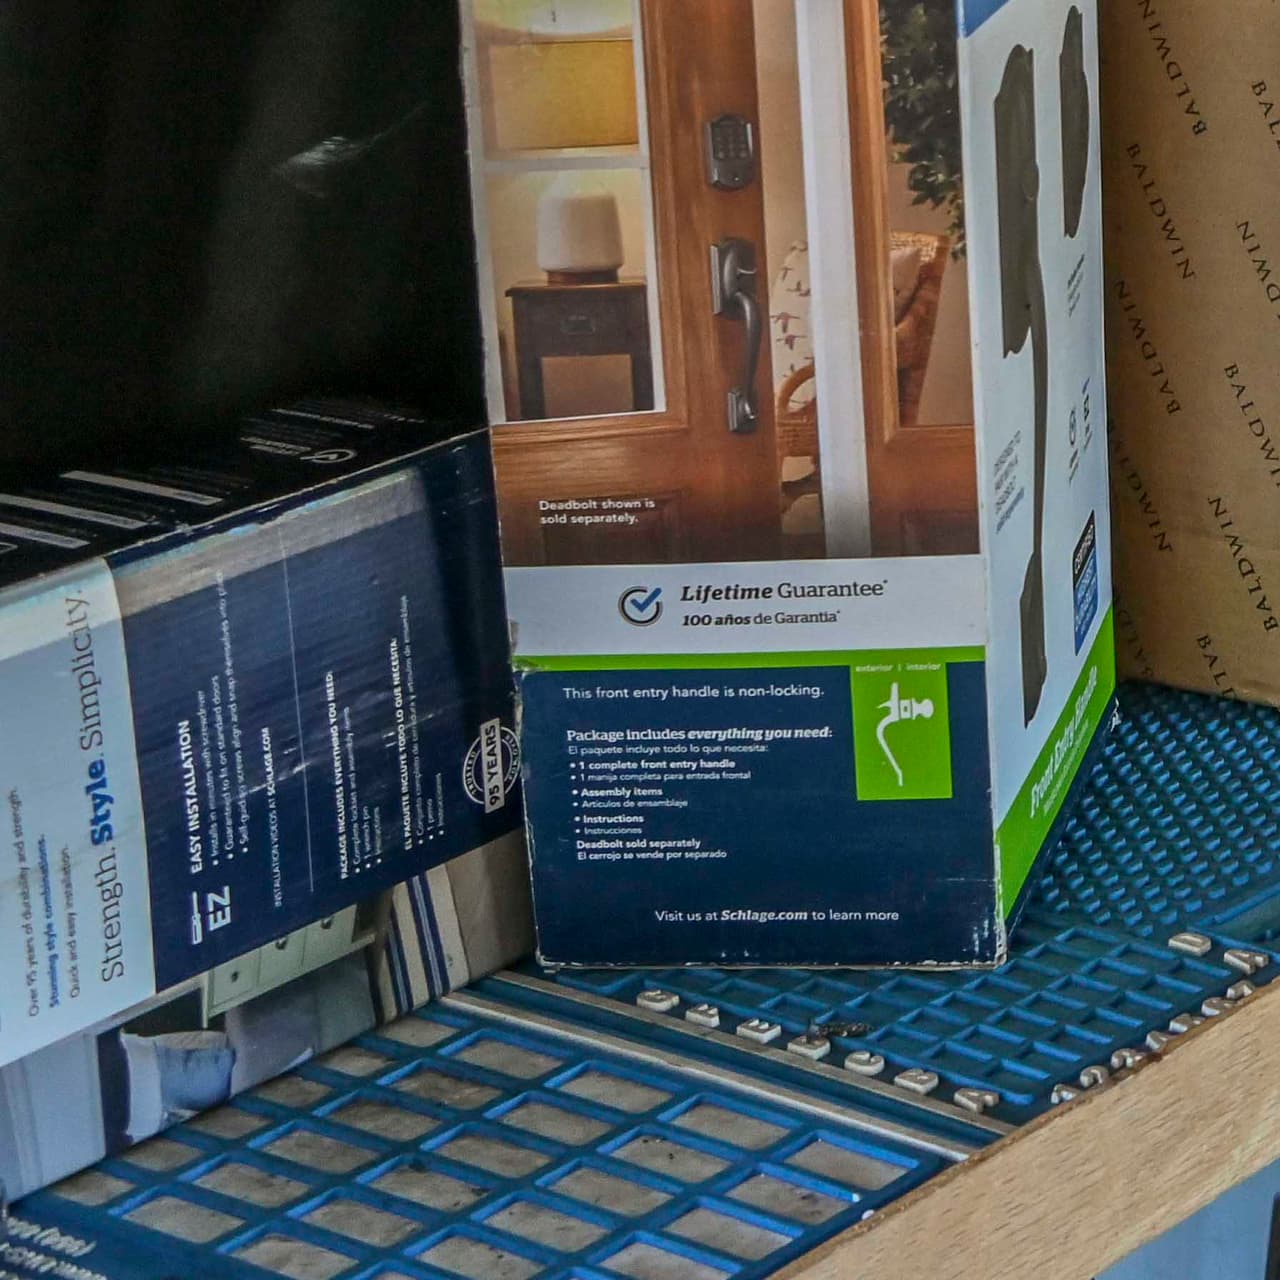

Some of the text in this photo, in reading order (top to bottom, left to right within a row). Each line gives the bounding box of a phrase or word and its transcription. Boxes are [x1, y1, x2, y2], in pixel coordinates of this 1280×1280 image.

[1127, 143, 1195, 280] BALDWIN
[1116, 281, 1181, 415] BALDWIN
[539, 498, 655, 511] Deadbolt shown is
[540, 511, 639, 526] sold separately.
[1208, 496, 1279, 632] BALDWIN
[680, 585, 773, 604] Lifetime
[682, 614, 712, 626] 100
[714, 612, 751, 626] años
[753, 612, 772, 625] de
[563, 684, 825, 701] This front entry handle is non-locking.
[390, 637, 413, 850] EL PAQUETE INCLUYE TODO LO QUE NECESITA:
[567, 726, 833, 743] Package includes everything you need:
[325, 671, 349, 879] PACKAGE INCLUDES EVERYTHING YOU NEED:
[485, 725, 500, 806] 95 YEARS
[579, 758, 736, 772] 1 complete front entry handle
[63, 589, 126, 983] Strength. Style. Simplicity.
[179, 720, 203, 874] EASY INSTALLATION
[581, 787, 663, 799] Assembly items
[1031, 752, 1054, 818] Front
[583, 814, 644, 824] Instructions
[577, 838, 700, 850] Deadbolt sold separately
[60, 845, 81, 998] Quick and easy installation.
[208, 885, 231, 931] EZ
[655, 909, 900, 923] Visit us at Schlage.com to learn more
